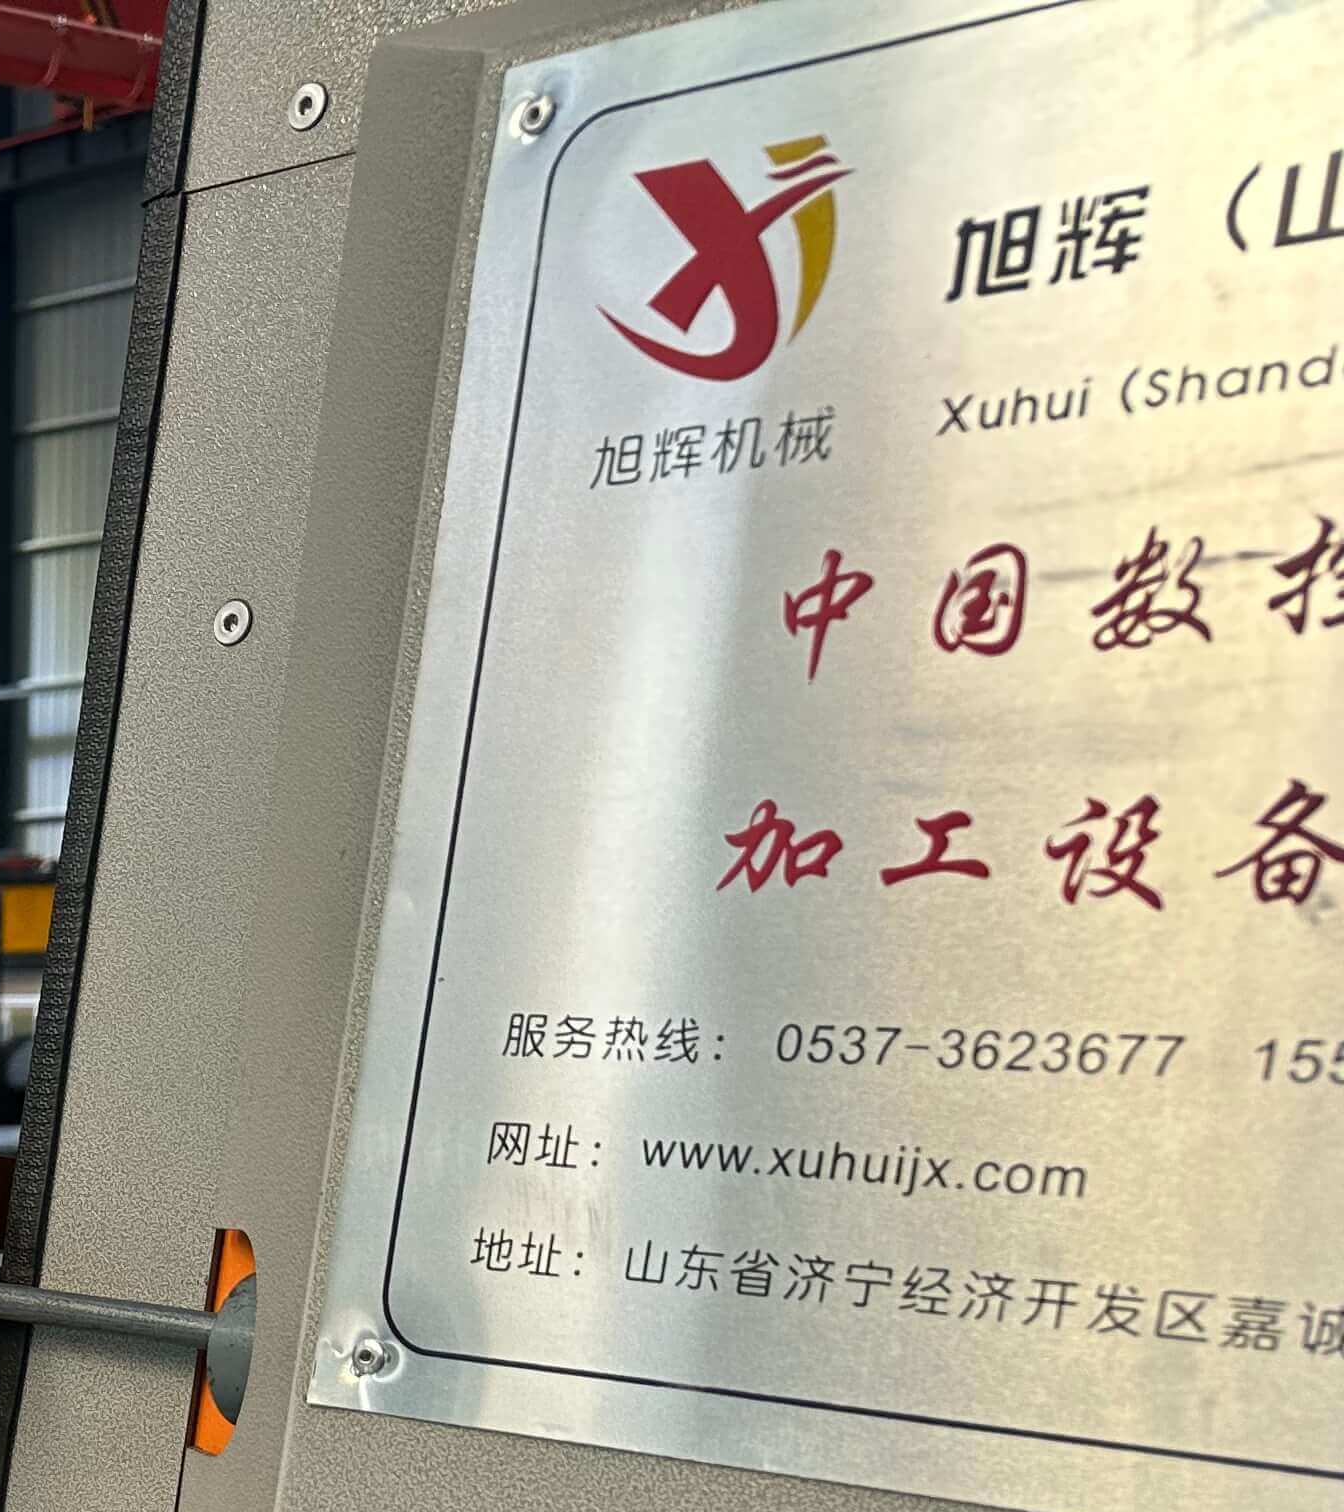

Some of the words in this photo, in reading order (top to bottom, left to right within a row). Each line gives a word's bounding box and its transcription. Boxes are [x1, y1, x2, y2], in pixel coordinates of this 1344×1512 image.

[936, 379, 1093, 437] Xuhui
[1120, 343, 1344, 414] (Shand
[589, 405, 838, 491] 旭辉机械
[715, 778, 1344, 911] 加工设备
[501, 1012, 728, 1066] 服务热线：
[775, 1021, 1189, 1080] 0537-3623677
[487, 1121, 602, 1171] 网址：
[640, 1134, 1089, 1199] www.xuhuijx.com
[471, 1227, 585, 1279] 地址：
